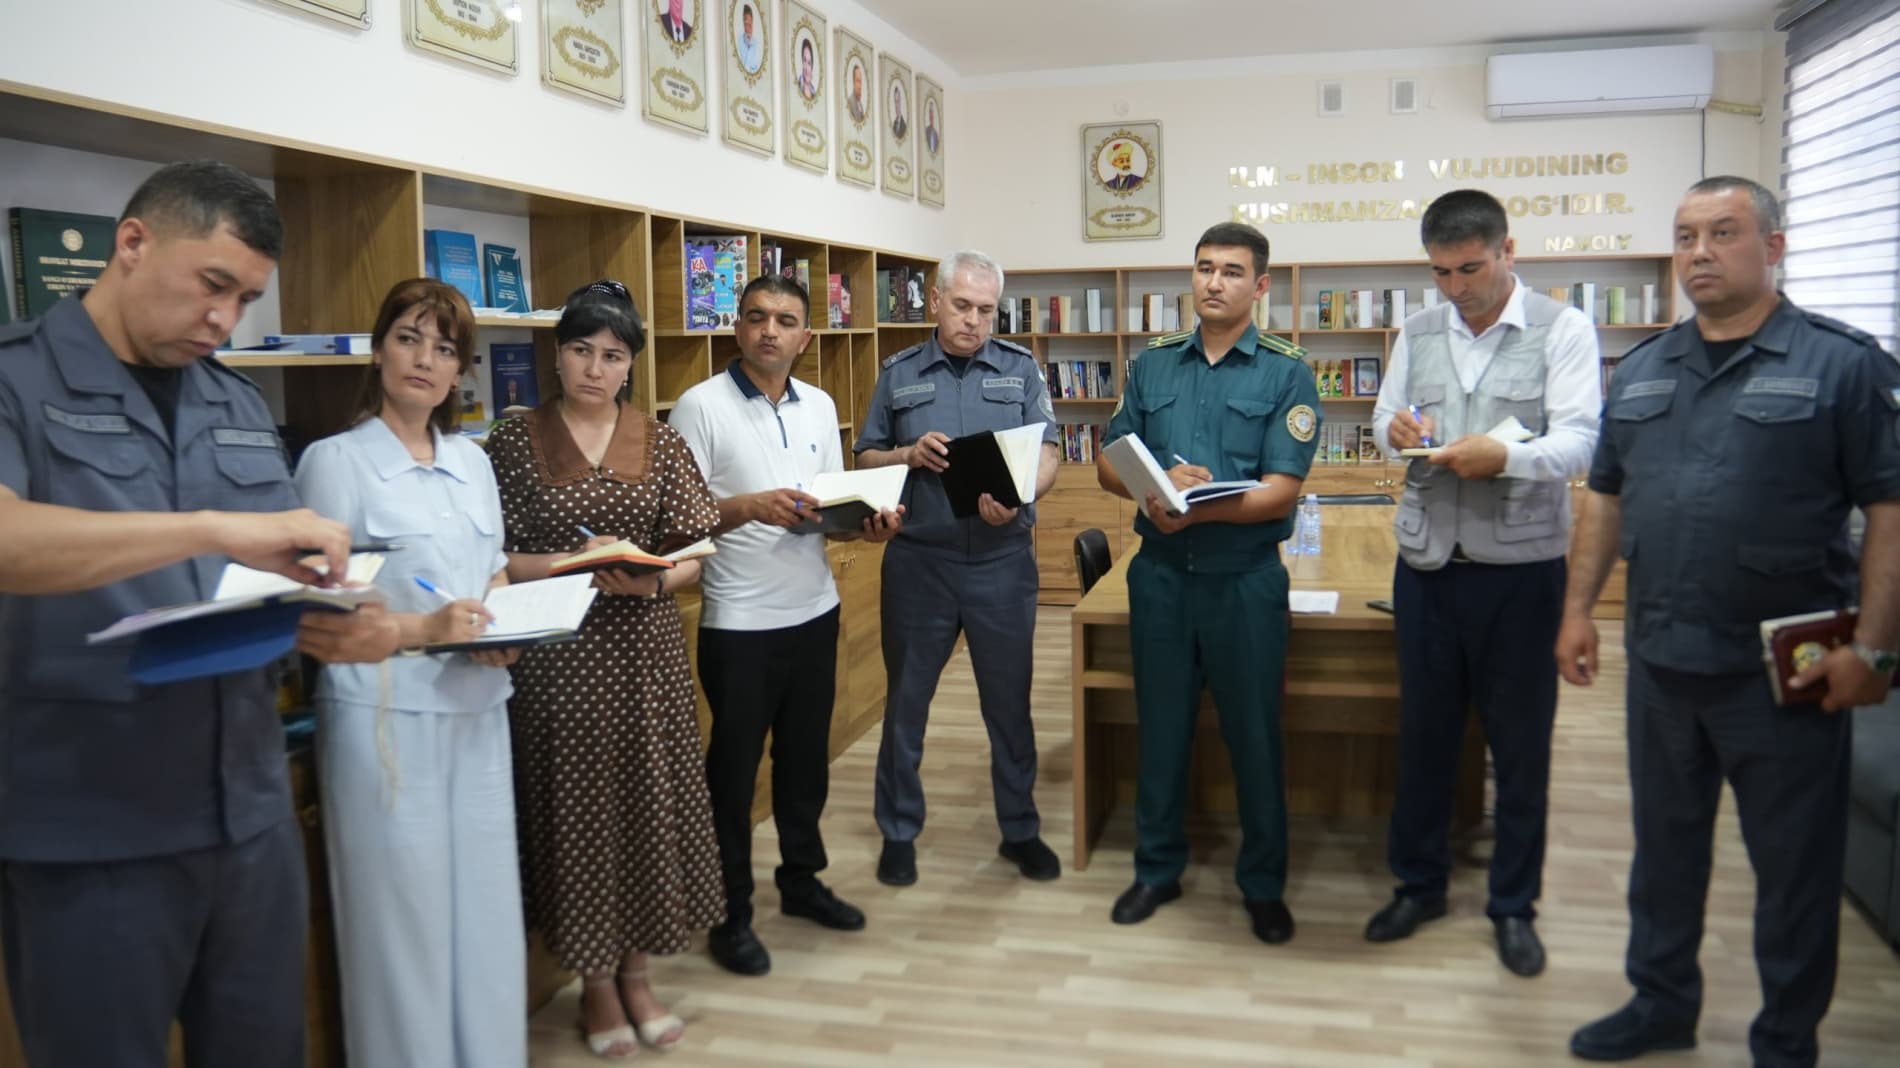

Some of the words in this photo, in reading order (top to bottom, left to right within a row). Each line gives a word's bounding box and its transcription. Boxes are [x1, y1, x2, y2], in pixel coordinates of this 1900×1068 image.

[1229, 165, 1280, 188] ILM
[1306, 159, 1404, 185] INSON
[1427, 152, 1629, 181] VUJUDINING
[1544, 233, 1633, 252] NAVOIY
